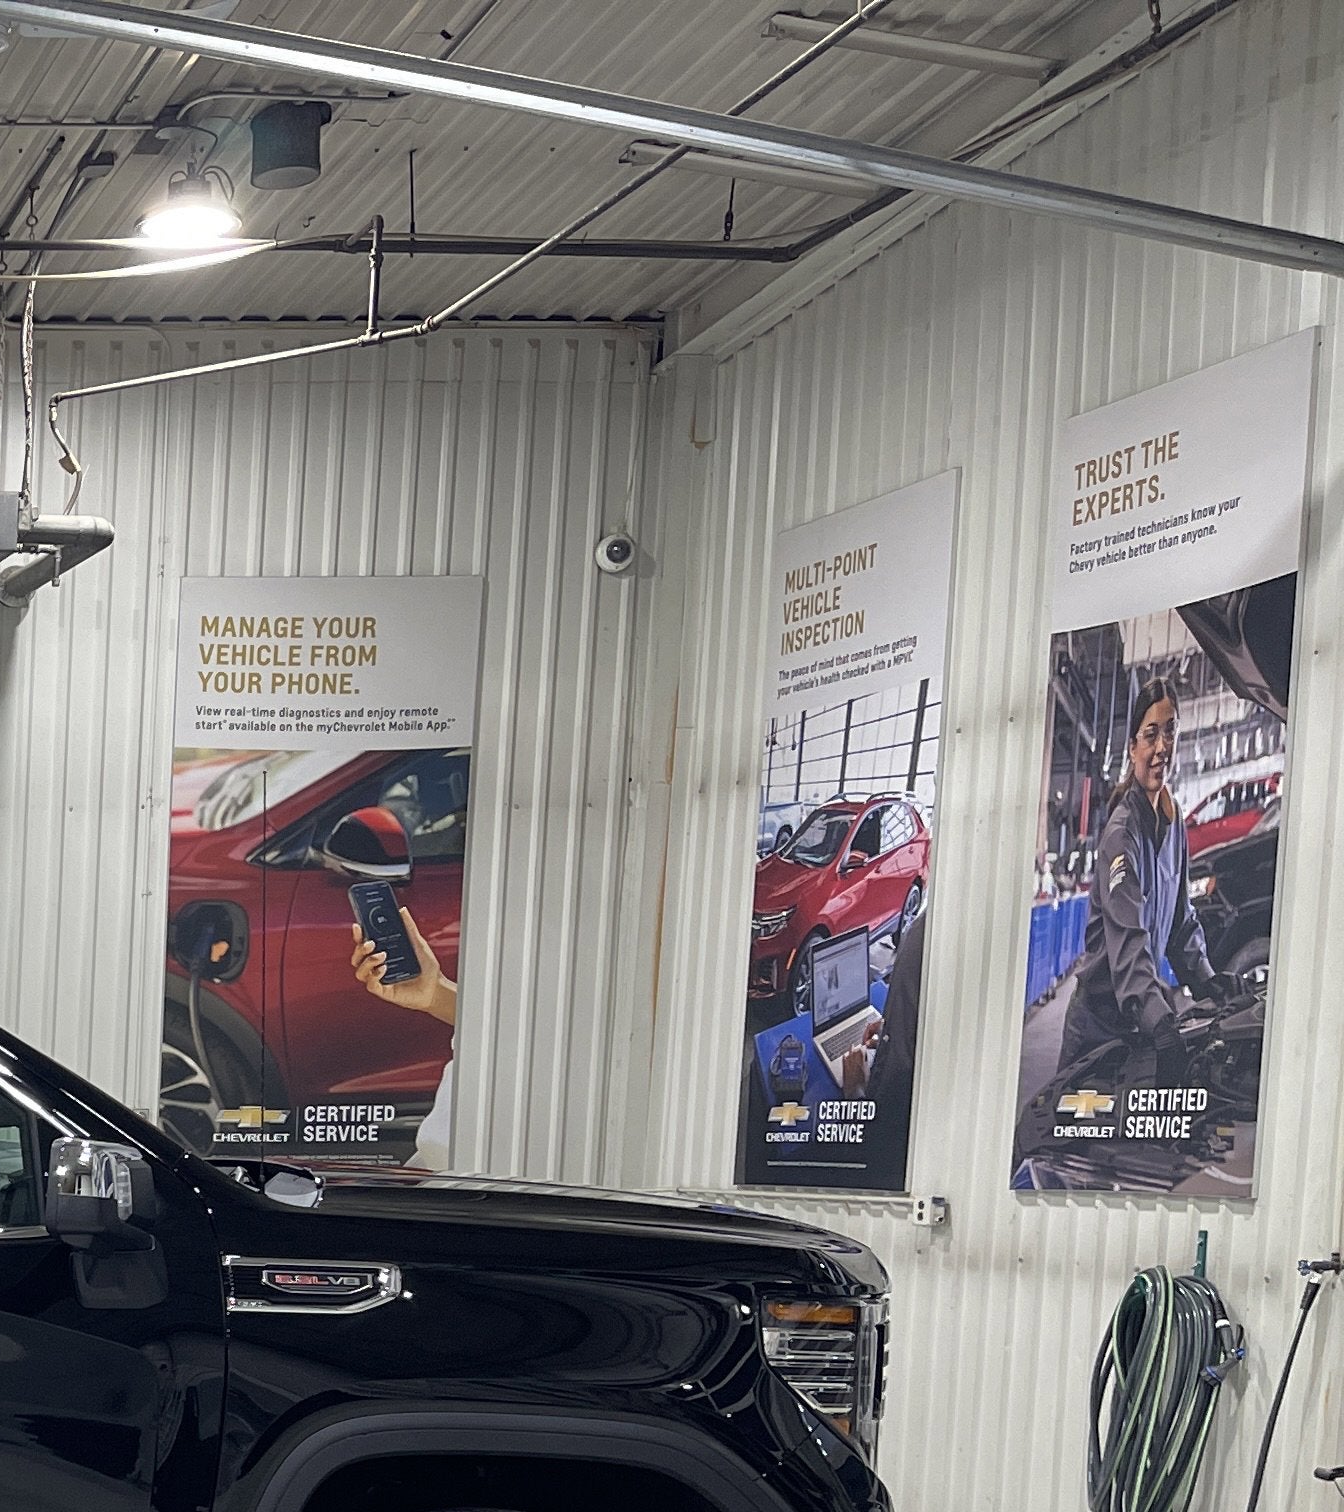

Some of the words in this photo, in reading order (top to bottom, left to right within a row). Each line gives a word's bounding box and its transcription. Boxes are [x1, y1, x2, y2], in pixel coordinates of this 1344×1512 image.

[1074, 446, 1136, 490] TRUST
[1141, 431, 1180, 468] THE
[1072, 474, 1165, 526] EXPERTS.
[1070, 539, 1102, 556] Factory
[1105, 527, 1136, 547] trained
[1137, 513, 1188, 537] technicians
[1191, 505, 1216, 522] know
[1218, 497, 1241, 516] your
[1069, 559, 1094, 573] Chevy
[1097, 550, 1126, 566] vehicle
[1129, 541, 1157, 559] better
[1159, 535, 1178, 550] than
[1181, 524, 1217, 545] anyone.
[785, 543, 878, 594] MULTI-POINT
[784, 586, 841, 624] VEHICLE
[201, 616, 304, 638] MANAGE
[312, 617, 376, 638] YOUR
[781, 610, 865, 655] INSPECTION
[199, 644, 301, 666] VEHICLE
[310, 646, 377, 666] FROM
[198, 671, 262, 694] YOUR
[271, 673, 360, 694] PHONE.
[196, 706, 221, 716] View
[225, 706, 275, 717] real-time
[279, 707, 341, 720] diagnostics
[345, 708, 364, 717] and
[367, 707, 396, 720] enjoy
[400, 707, 438, 716] remote
[229, 721, 276, 731] available
[280, 723, 292, 731] on
[296, 721, 313, 731] the
[317, 722, 385, 734] myChevrolet
[389, 721, 423, 731] Mobile
[819, 1101, 875, 1120] CERTIFIED
[1128, 1088, 1208, 1111] CERTIFIED
[304, 1105, 395, 1122] CERTIFIED
[213, 1133, 290, 1142] CHEVROLET
[303, 1125, 378, 1142] SERVICE
[766, 1132, 810, 1142] CHEVROLET
[817, 1124, 864, 1142] SERVICE
[1054, 1126, 1115, 1138] CHEVROLET
[1125, 1116, 1191, 1138] SERVICE
